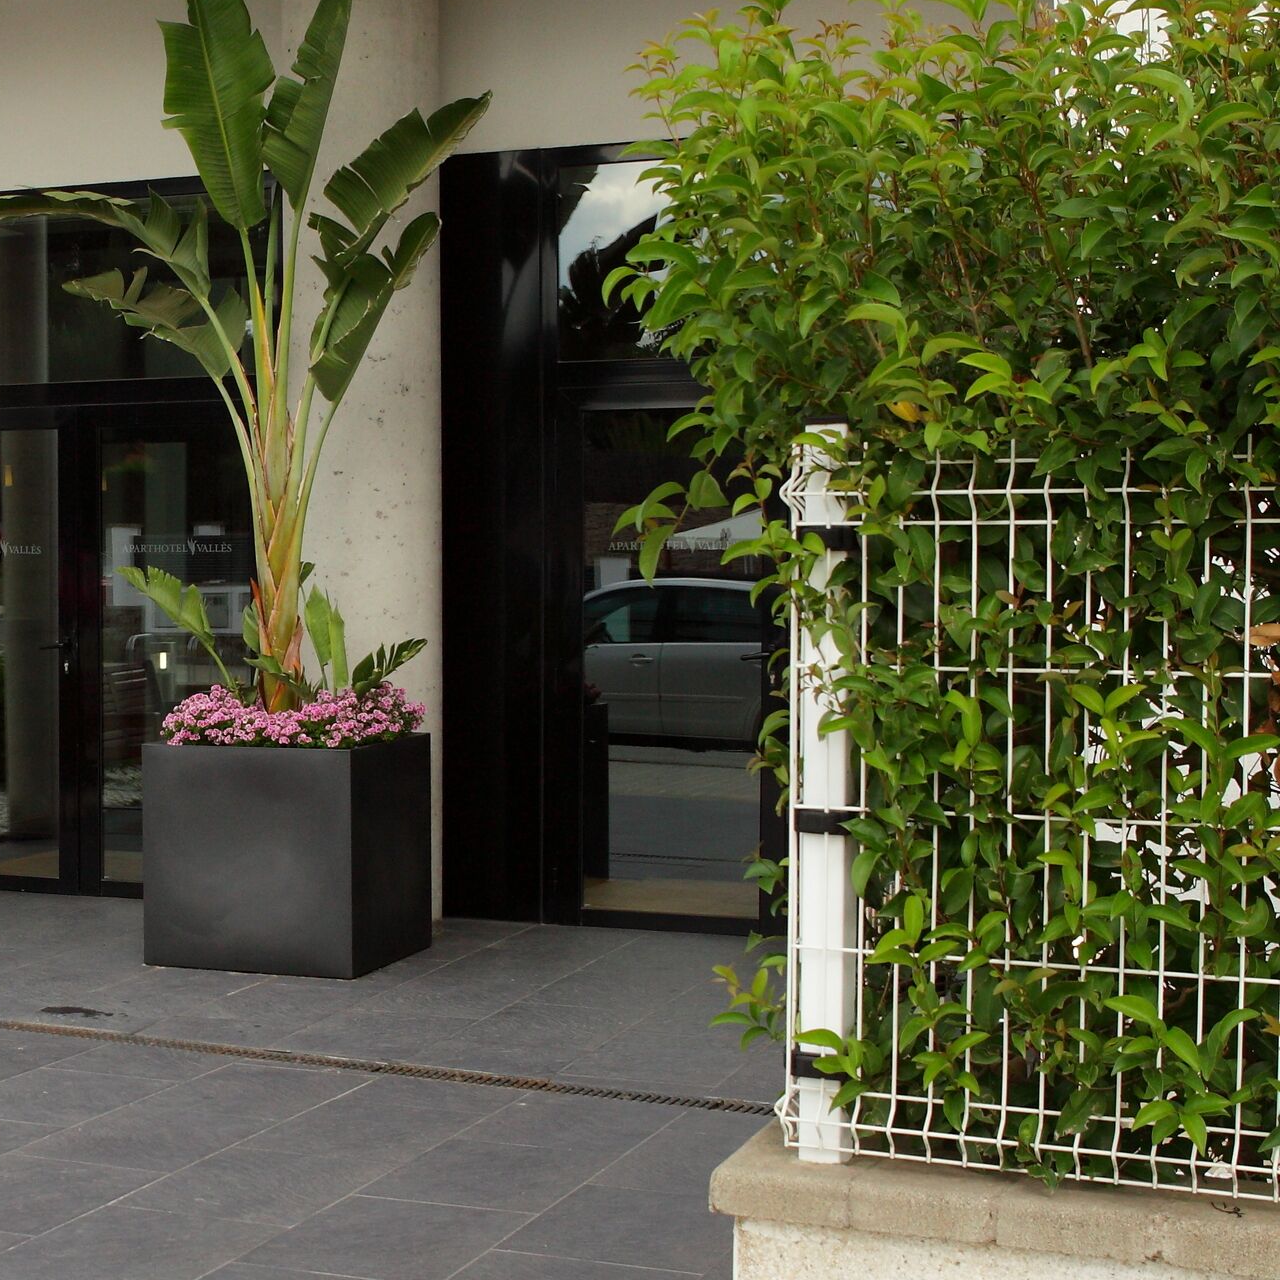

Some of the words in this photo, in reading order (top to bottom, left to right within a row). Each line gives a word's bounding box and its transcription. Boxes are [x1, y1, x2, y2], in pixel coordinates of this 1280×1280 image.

[8, 543, 42, 555] VALLÈS
[122, 543, 188, 553] APARTHOTEL
[196, 542, 232, 552] VALLÈS
[608, 540, 687, 551] APARTTEL
